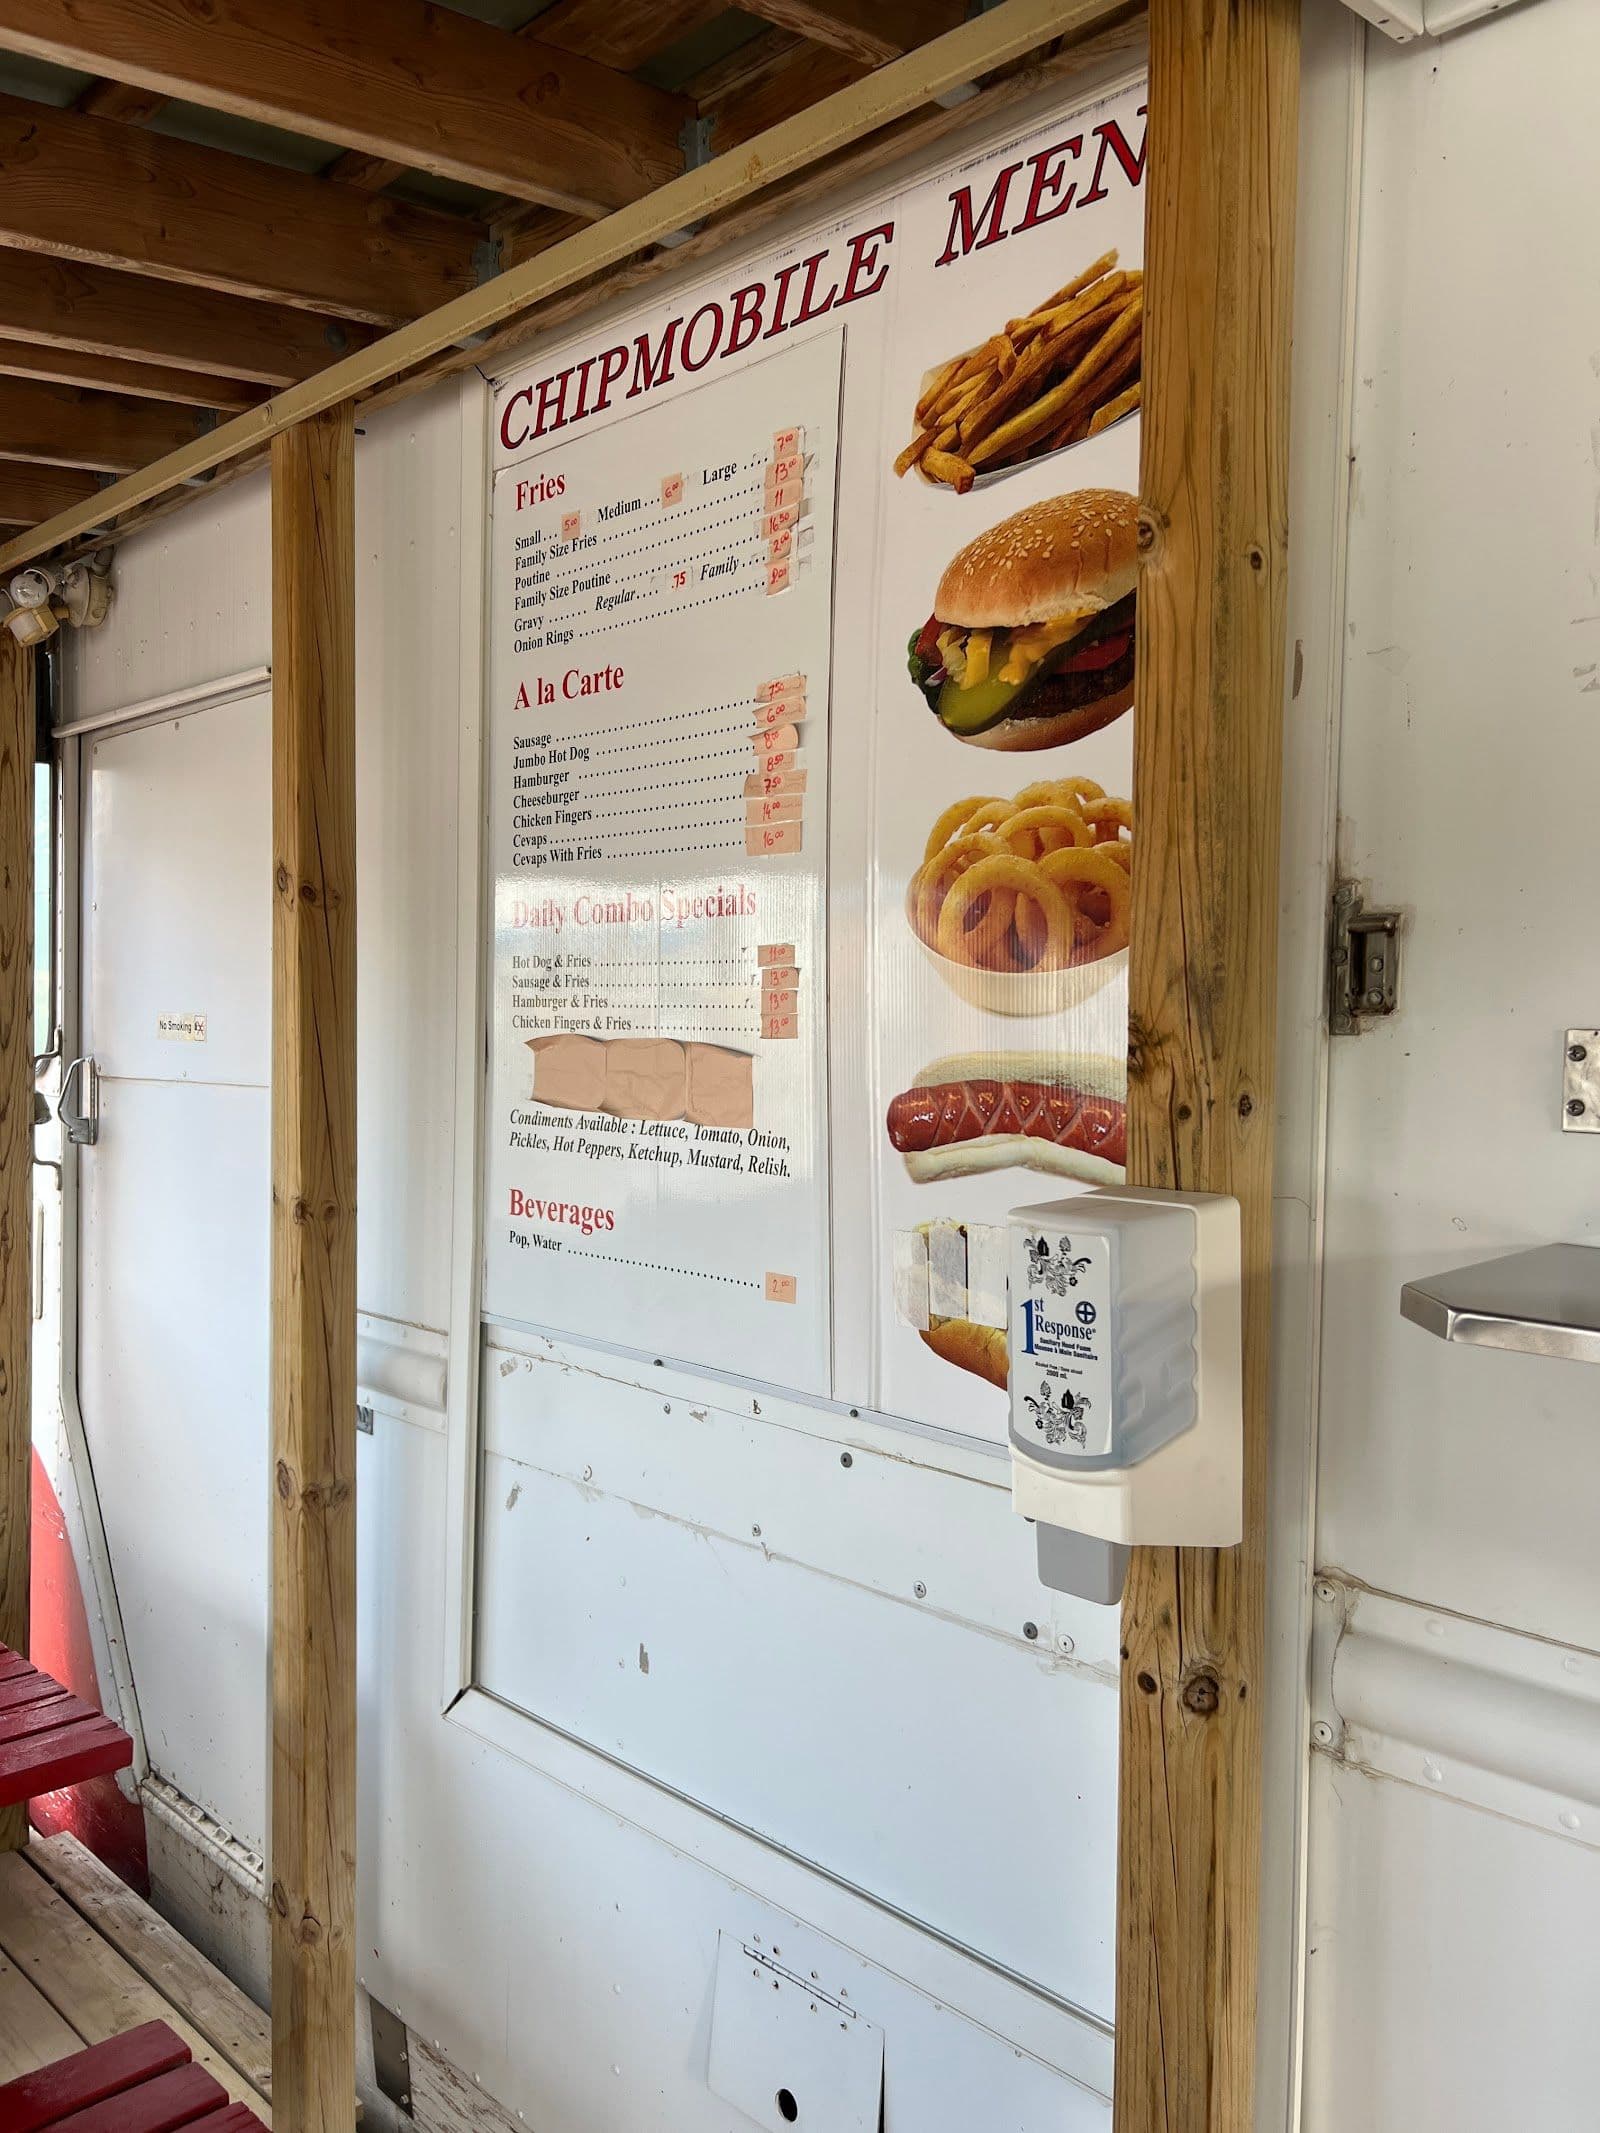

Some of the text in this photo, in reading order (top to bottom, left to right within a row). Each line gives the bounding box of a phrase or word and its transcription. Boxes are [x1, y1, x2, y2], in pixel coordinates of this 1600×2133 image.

[500, 105, 1147, 451] CHIPMOBILE MEN
[515, 473, 565, 512] Fries
[515, 530, 541, 550] Small
[597, 499, 641, 522] Medium
[702, 461, 737, 485] Large
[515, 551, 547, 571] Family
[549, 544, 569, 561] Size
[572, 532, 597, 554] Fries
[514, 568, 550, 591] Poutine
[514, 590, 546, 611] Family
[549, 582, 569, 601] Size
[572, 571, 611, 595] Poutine
[514, 614, 544, 633] Gravy
[595, 588, 636, 611] Regular
[700, 556, 739, 581] Family
[514, 631, 542, 653] Onion
[546, 626, 573, 646] Rings
[514, 664, 624, 710] A la Carte
[513, 732, 551, 751] Sausage
[513, 752, 546, 770] Jumbo
[549, 748, 567, 764] Hot
[569, 745, 589, 762] Dog
[513, 770, 569, 790] Hamburger
[513, 788, 580, 810] Cheeseburger
[513, 812, 552, 829] Chicken
[555, 808, 592, 826] Fingers
[513, 832, 547, 850] Cevaps
[513, 851, 547, 868] Cevaps
[550, 847, 574, 864] With
[577, 846, 601, 861] Fries
[513, 884, 756, 934] Daily Combo Specials
[512, 956, 530, 969] Hot
[533, 955, 551, 971] Dog
[554, 955, 562, 967] &
[566, 954, 591, 968] Fries
[512, 975, 550, 992] Sausage
[553, 975, 561, 988] &
[565, 975, 589, 988] Fries
[512, 994, 568, 1012] Hamburger
[571, 995, 580, 1008] &
[583, 995, 608, 1008] Fries
[160, 1020, 192, 1034] No Smoking
[512, 1015, 550, 1029] Chicken
[554, 1017, 590, 1032] Fingers
[593, 1017, 603, 1030] &
[606, 1016, 631, 1030] Fries
[510, 1109, 573, 1129] Condiments
[576, 1116, 628, 1135] Available
[640, 1119, 689, 1140] Lettuce,
[694, 1124, 743, 1147] Tomato,
[747, 1128, 790, 1153] Onion,
[509, 1132, 790, 1178] Pickles, Hot Peppers, Ketchup, Mustard, Relish.
[509, 1188, 615, 1236] Beverages
[509, 1230, 530, 1248] Pop,
[533, 1234, 562, 1252] Water
